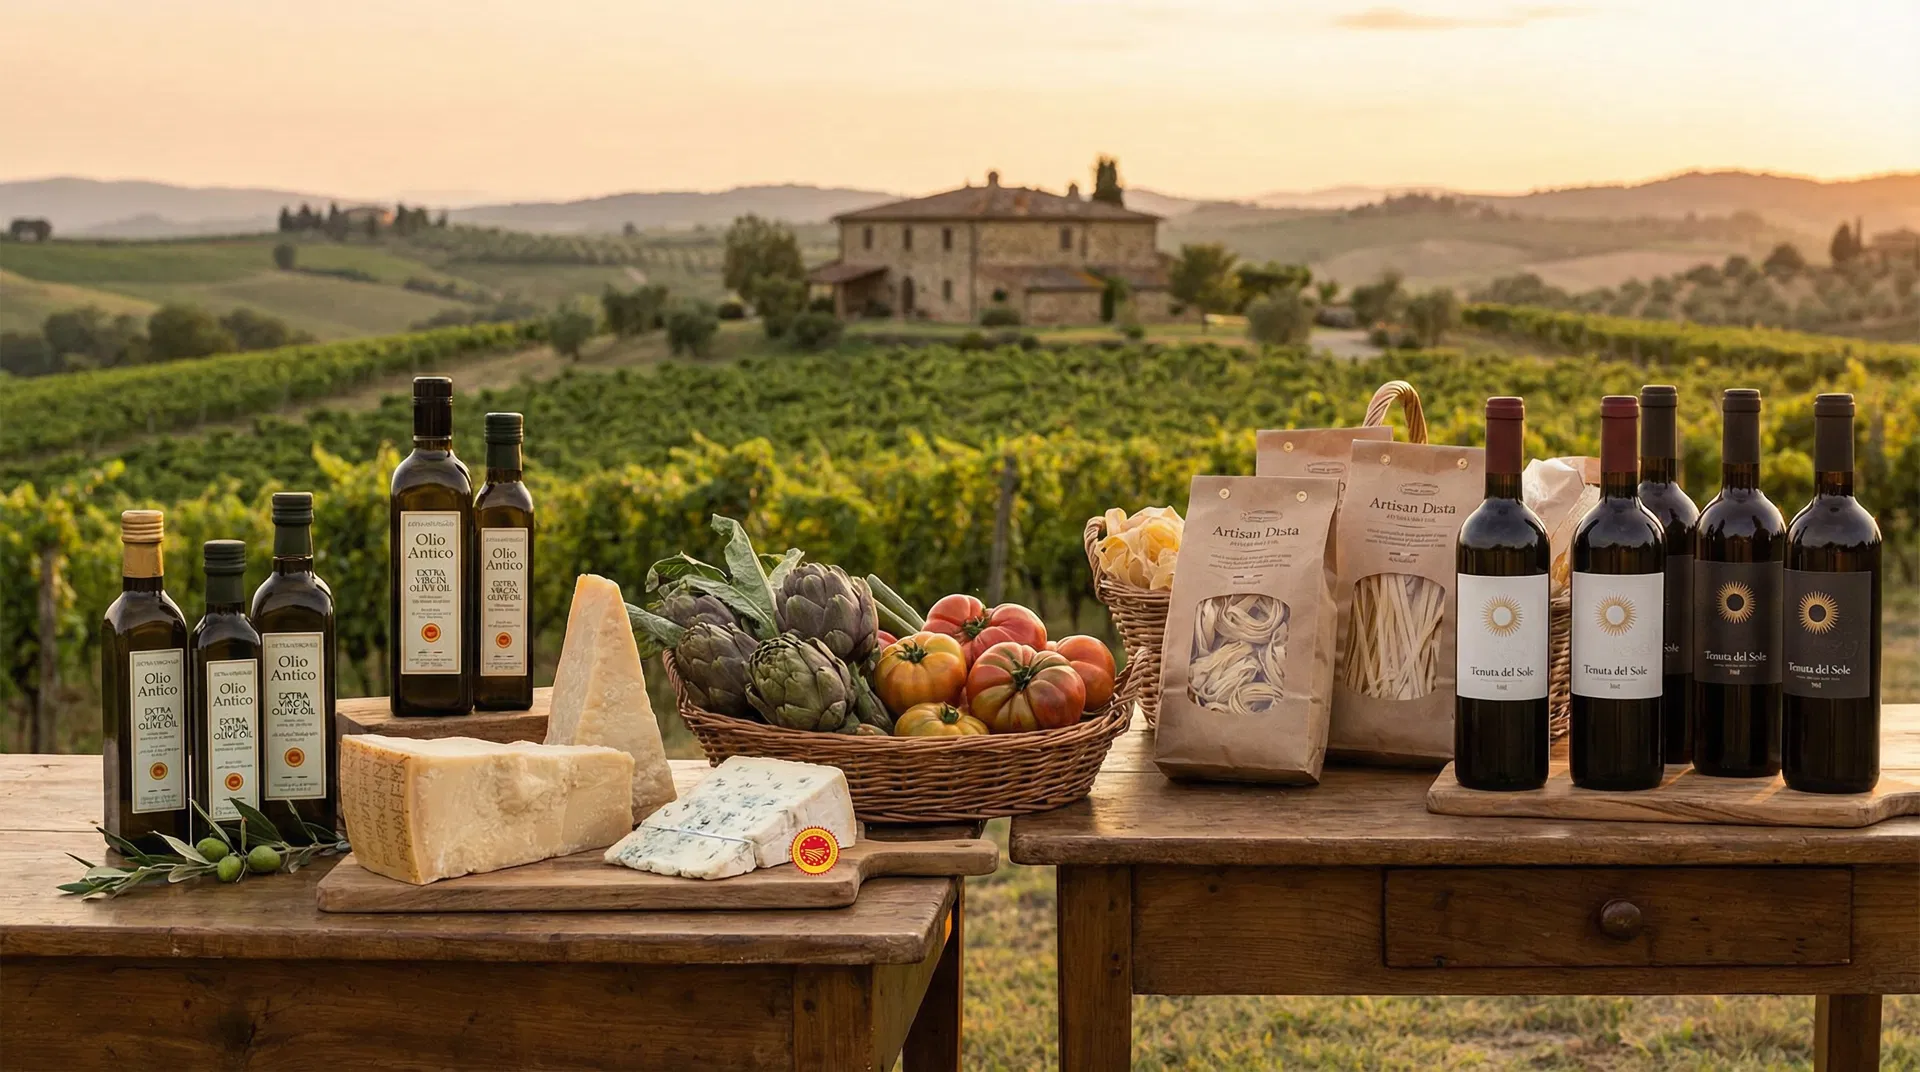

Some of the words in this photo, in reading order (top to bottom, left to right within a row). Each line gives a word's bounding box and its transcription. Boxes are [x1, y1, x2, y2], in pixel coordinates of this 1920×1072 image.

[1369, 497, 1418, 513] Artisan
[1212, 526, 1261, 539] Artisan
[416, 533, 446, 546] Olio
[408, 547, 454, 559] Antico
[492, 547, 517, 559] Olio
[486, 560, 523, 570] Antico
[437, 584, 452, 592] OIL
[279, 655, 308, 668] Olio
[1704, 650, 1732, 661] Tenuta
[1734, 652, 1747, 662] del
[1749, 652, 1767, 662] Sole
[1470, 666, 1500, 677] Tenuta
[1501, 667, 1515, 677] del
[1516, 667, 1534, 677] Sole
[1583, 664, 1612, 676] Tenuta
[1614, 665, 1628, 676] del
[1630, 665, 1648, 676] Sole
[1788, 662, 1814, 674] Tenuta
[1815, 664, 1829, 675] del
[1830, 665, 1851, 675] Sole
[144, 672, 171, 684] Olio
[270, 669, 316, 681] Antico
[137, 684, 178, 697] Antico
[220, 682, 246, 694] Olio
[213, 695, 253, 707] Antico
[278, 692, 309, 700] EXTRA
[144, 707, 172, 715] EXTRA
[272, 708, 299, 716] OLIVE
[300, 707, 315, 715] OIL
[164, 720, 179, 728] OIL
[219, 717, 247, 725] EXTRA
[239, 731, 253, 739] OIL
